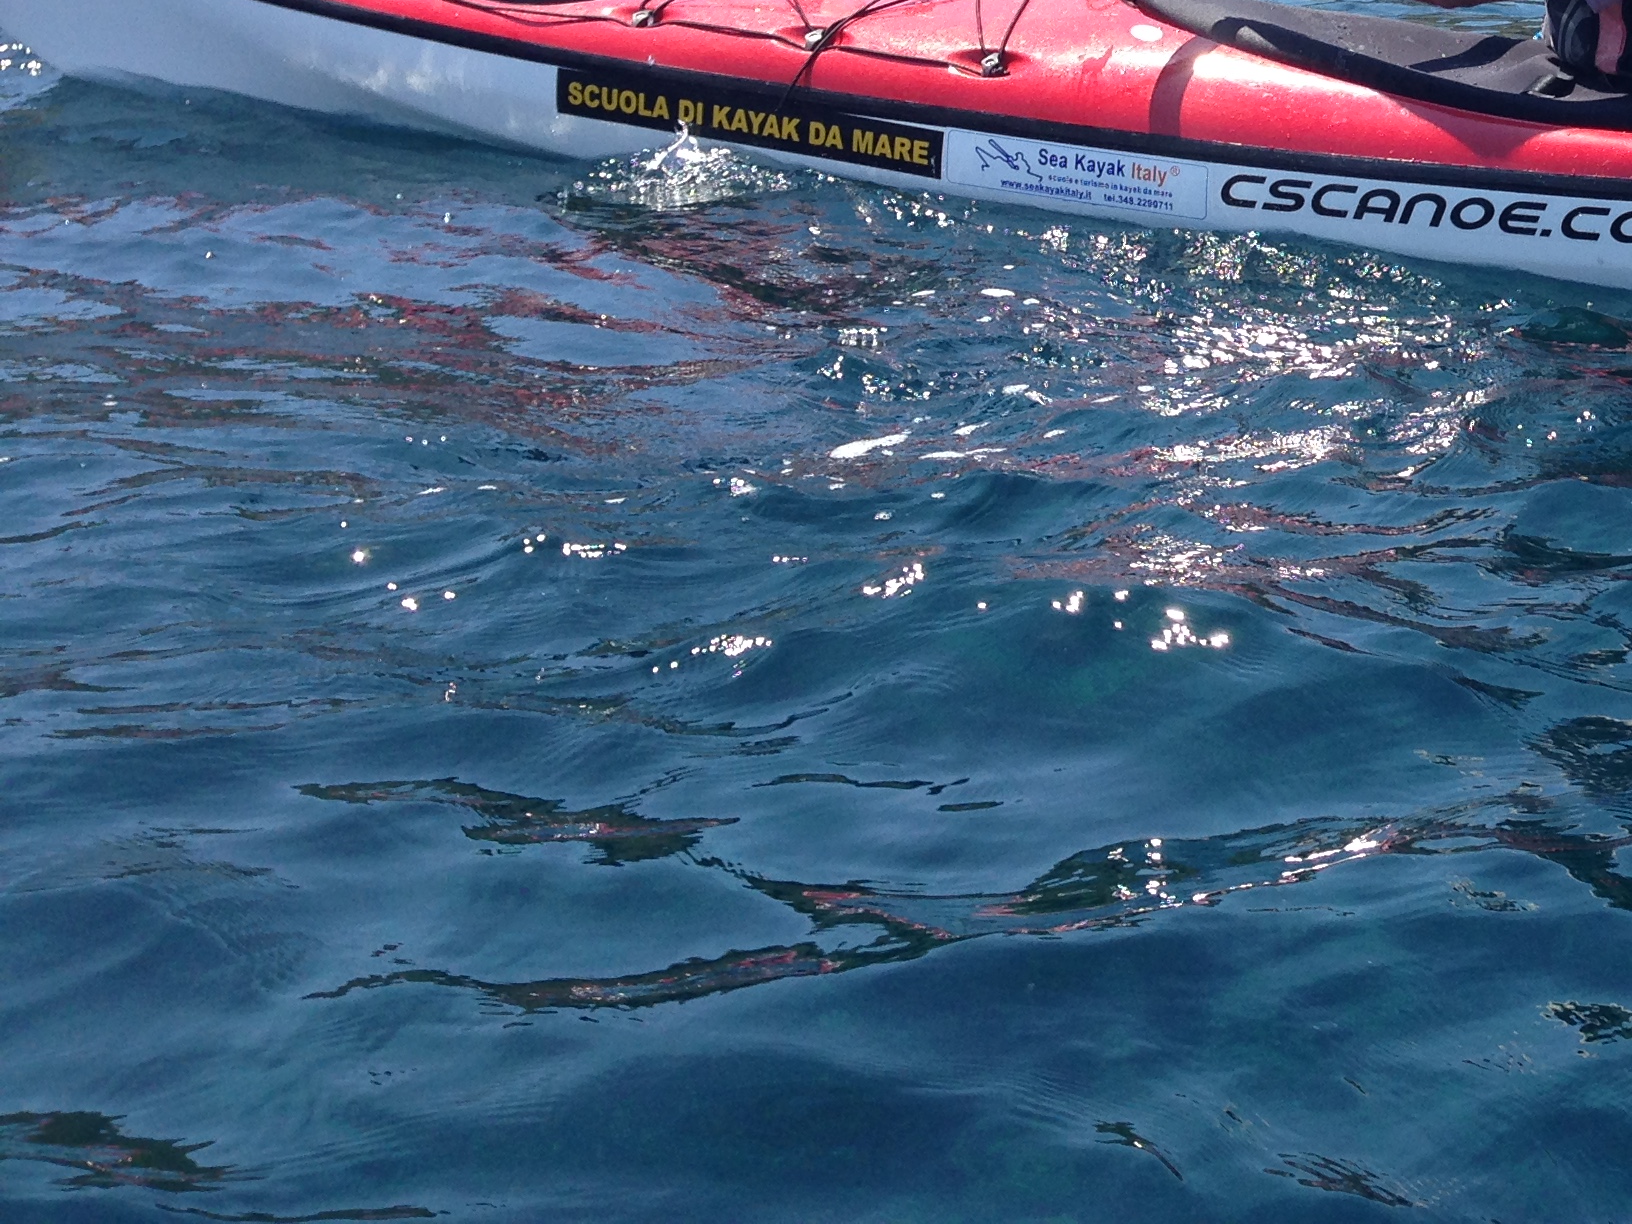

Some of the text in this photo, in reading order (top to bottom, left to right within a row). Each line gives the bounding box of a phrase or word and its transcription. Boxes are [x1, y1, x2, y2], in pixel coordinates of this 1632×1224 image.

[568, 81, 930, 166] SCUOLA DI KAYAK DA MARE
[1038, 148, 1168, 187] Sea Kayak Italy
[1000, 179, 1092, 201] www.seakayakitaly.it
